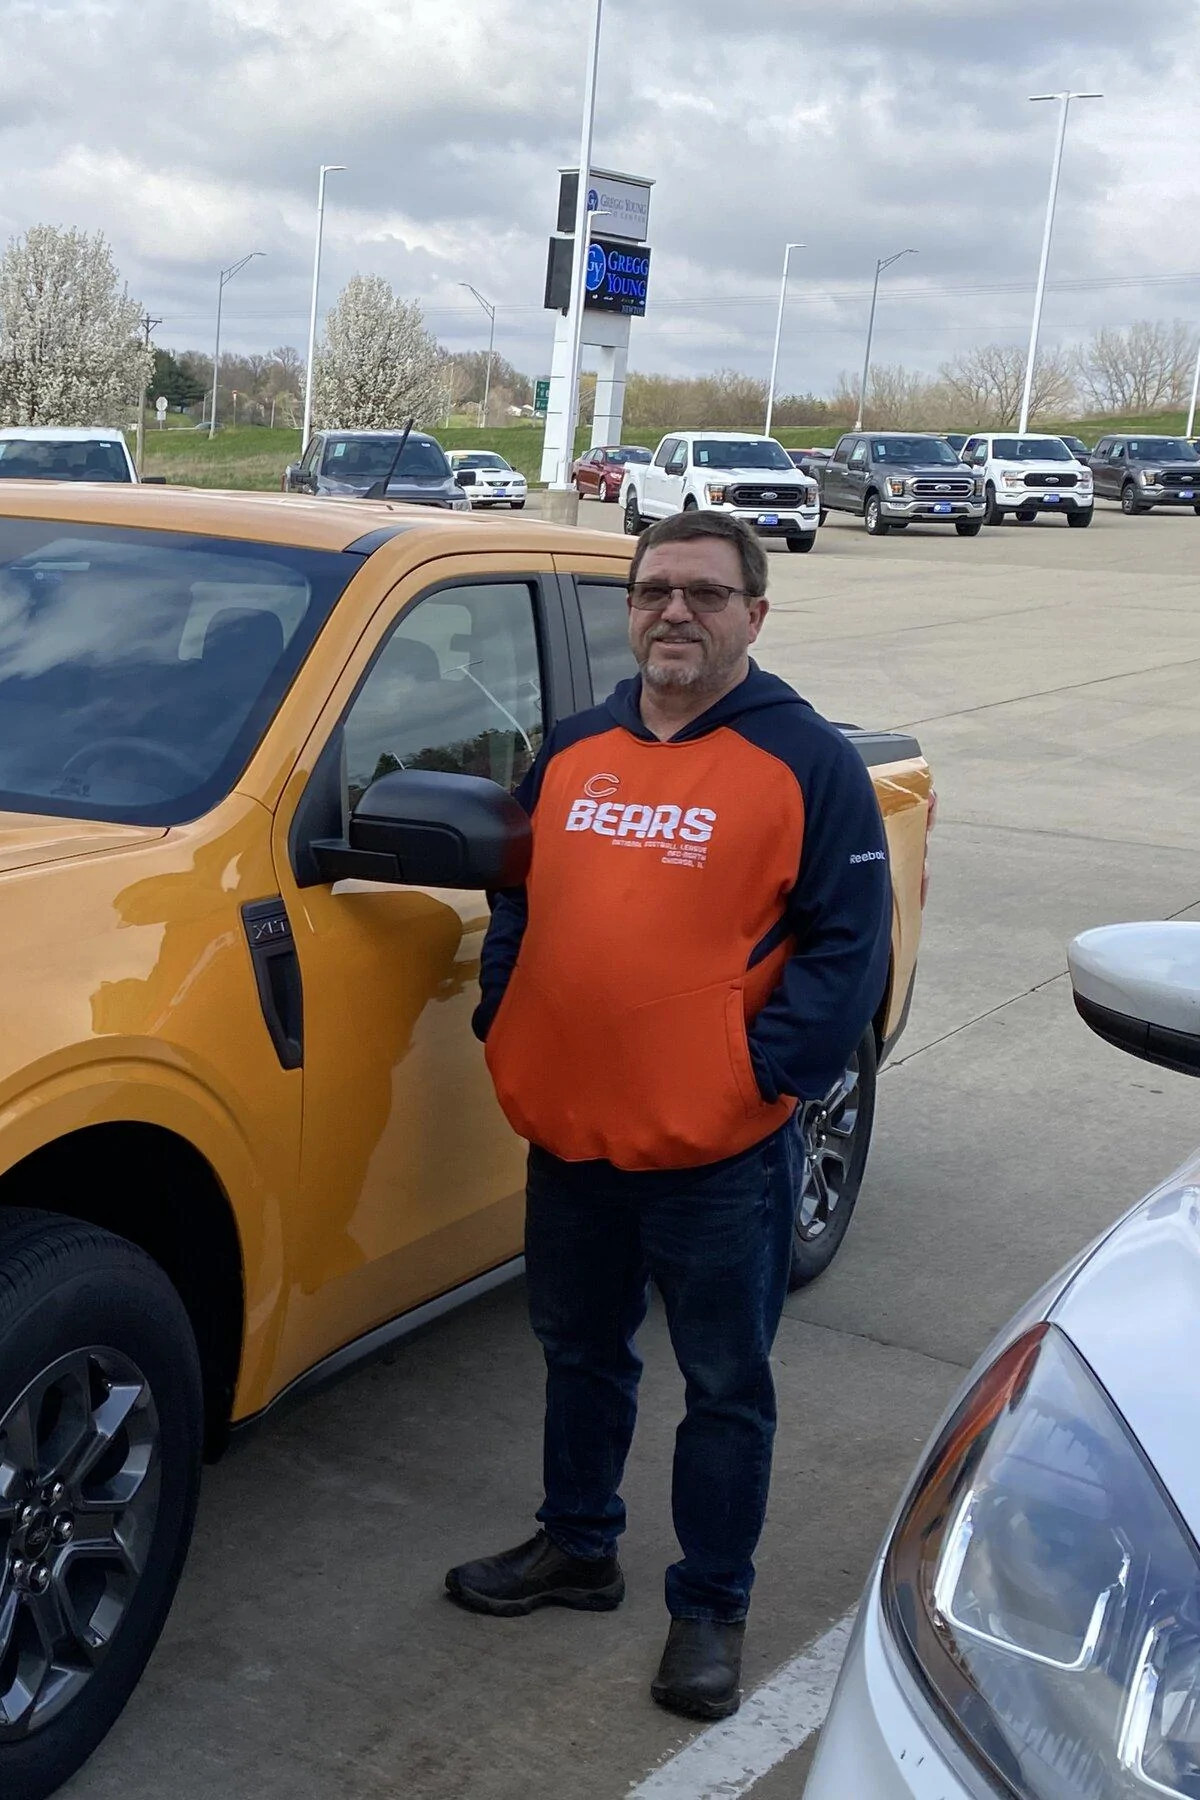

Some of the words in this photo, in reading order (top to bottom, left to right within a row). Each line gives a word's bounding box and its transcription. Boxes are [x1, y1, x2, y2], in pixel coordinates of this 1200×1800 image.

[600, 194, 624, 210] GREGG
[625, 199, 647, 215] YOUNG
[608, 251, 648, 276] GREGG
[606, 273, 646, 297] YOUNG
[565, 799, 717, 842] BEARS
[611, 839, 642, 848] NATIONAL
[644, 841, 678, 850] FOOTBALL
[680, 844, 708, 853] LEAGUE
[850, 850, 886, 864] Reebok
